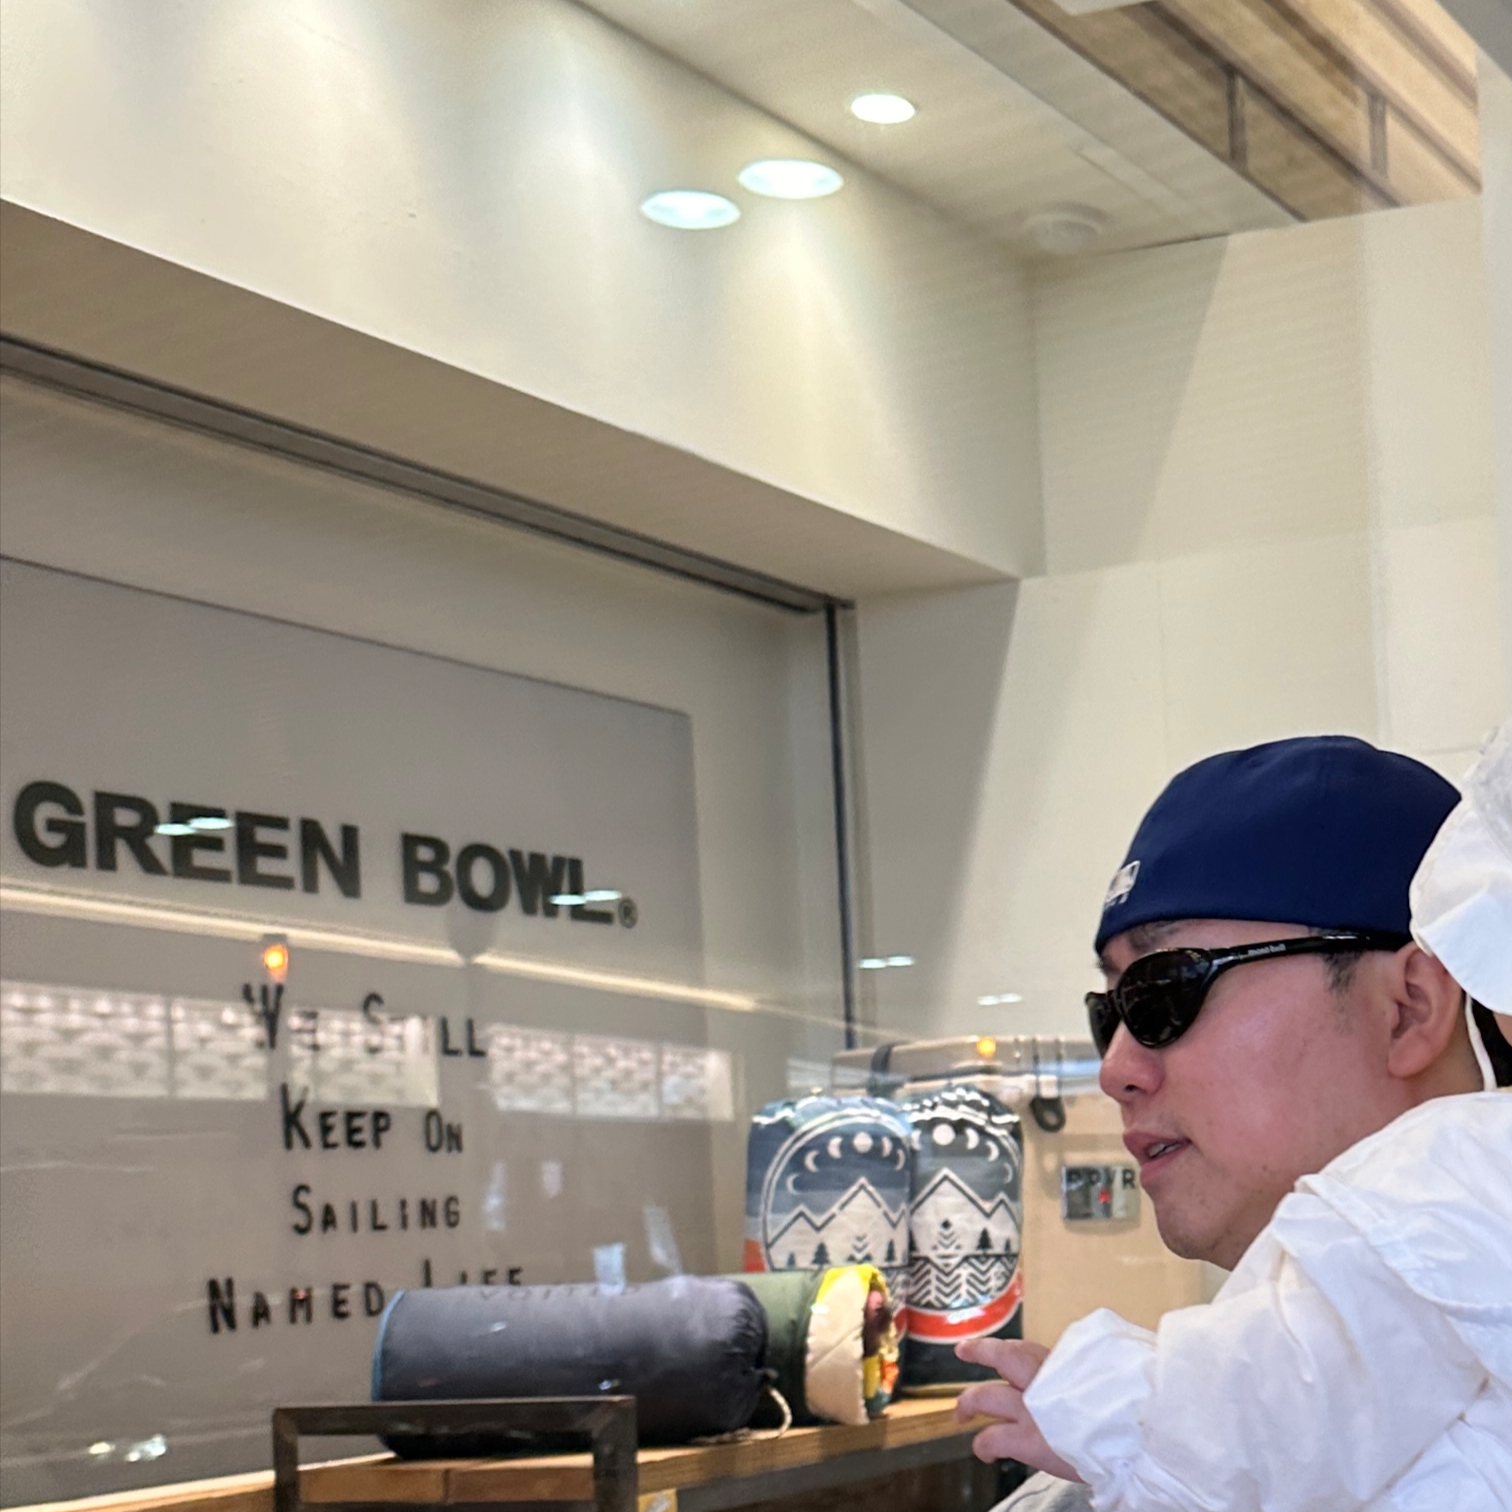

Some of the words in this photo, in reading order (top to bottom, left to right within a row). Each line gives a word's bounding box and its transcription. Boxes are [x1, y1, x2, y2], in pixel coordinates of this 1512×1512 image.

[12, 780, 362, 899] GREEN
[362, 992, 488, 1058] SLL
[280, 1082, 392, 1150] KEEP
[425, 1108, 463, 1153] ON
[292, 1184, 460, 1236] SAILING
[207, 1277, 385, 1334] NAMED
